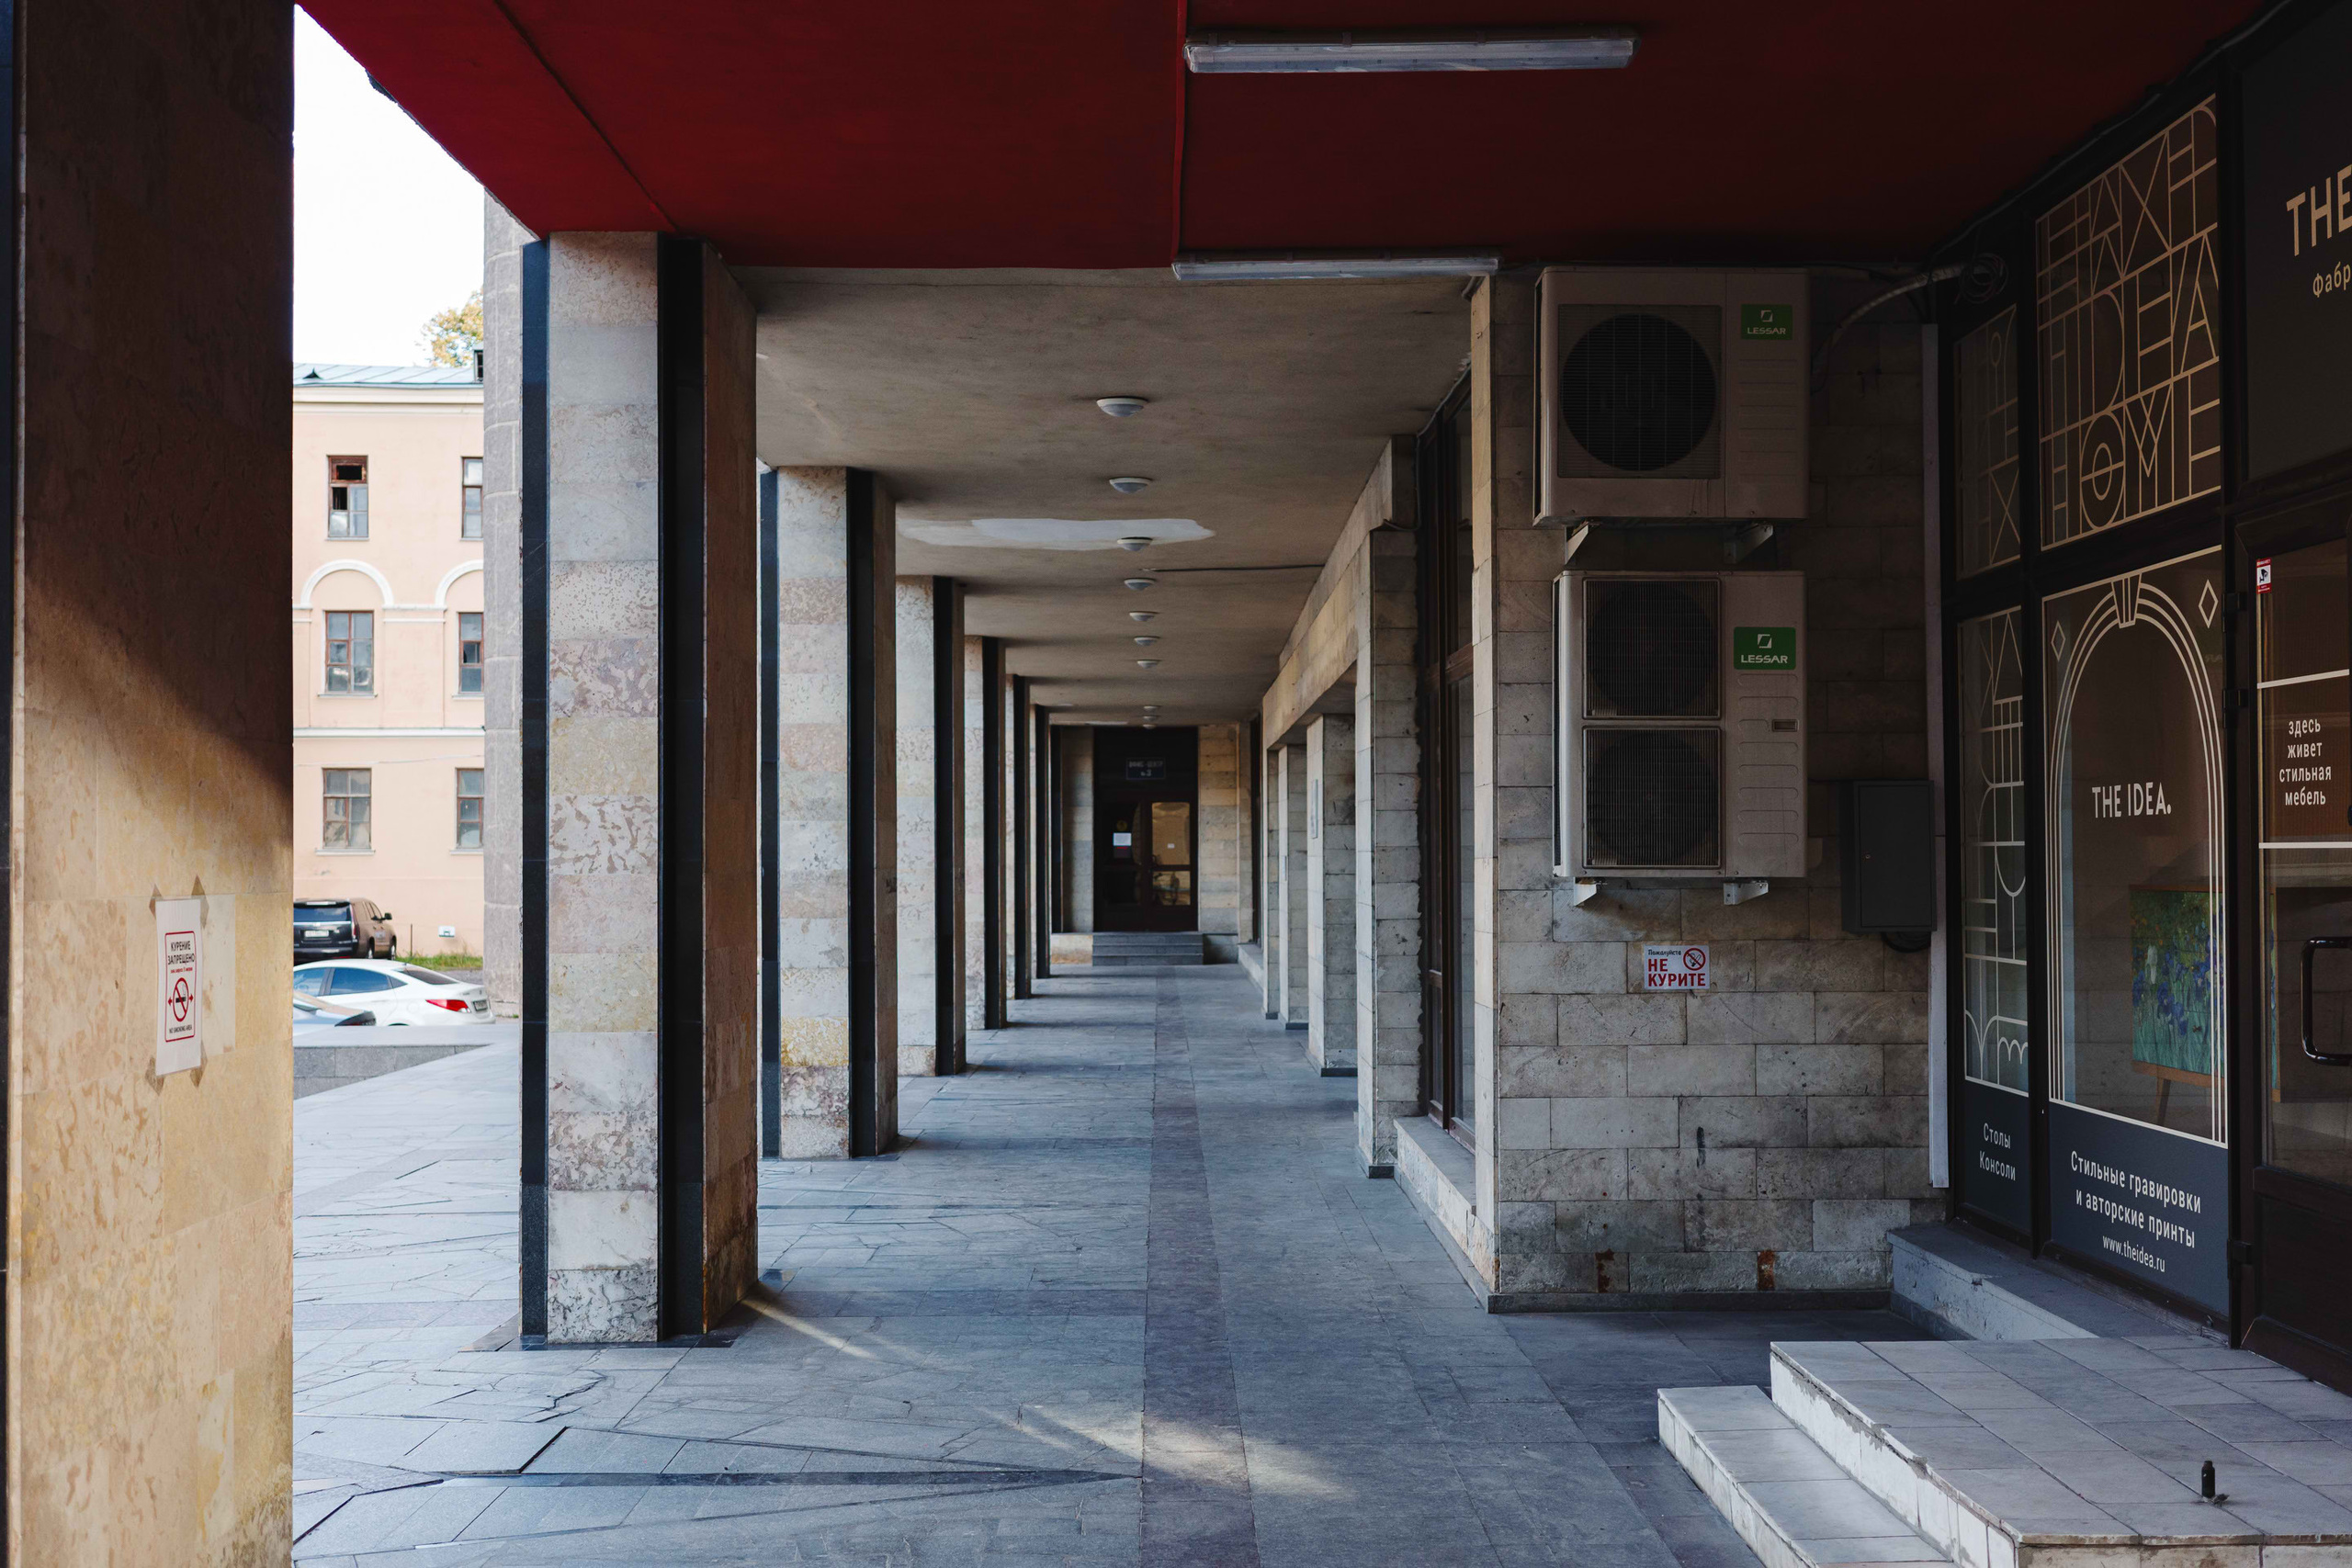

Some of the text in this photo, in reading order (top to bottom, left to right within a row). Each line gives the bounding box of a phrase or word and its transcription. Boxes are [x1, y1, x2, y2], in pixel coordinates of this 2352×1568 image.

[2286, 164, 2352, 256] THE
[1741, 655, 1788, 663] LESSAR
[2288, 719, 2321, 738] здесь
[2287, 741, 2323, 759] живет
[2279, 765, 2332, 783] стильная
[2092, 782, 2172, 818] THE IDEA.
[2285, 789, 2326, 806] мебель
[171, 941, 191, 952] КУРЕНИЕ
[168, 953, 195, 965] ЗАПРЕЩЕНО
[1648, 958, 1668, 972] НЕ
[1648, 973, 1705, 987] КУРИТЕ
[1984, 1122, 2010, 1149] Столы
[1980, 1150, 2016, 1181] Консоли
[2071, 1150, 2201, 1213] Стильные гравировки
[2076, 1188, 2195, 1248] и авторские принты
[2103, 1235, 2165, 1273] www.theidea.ru
